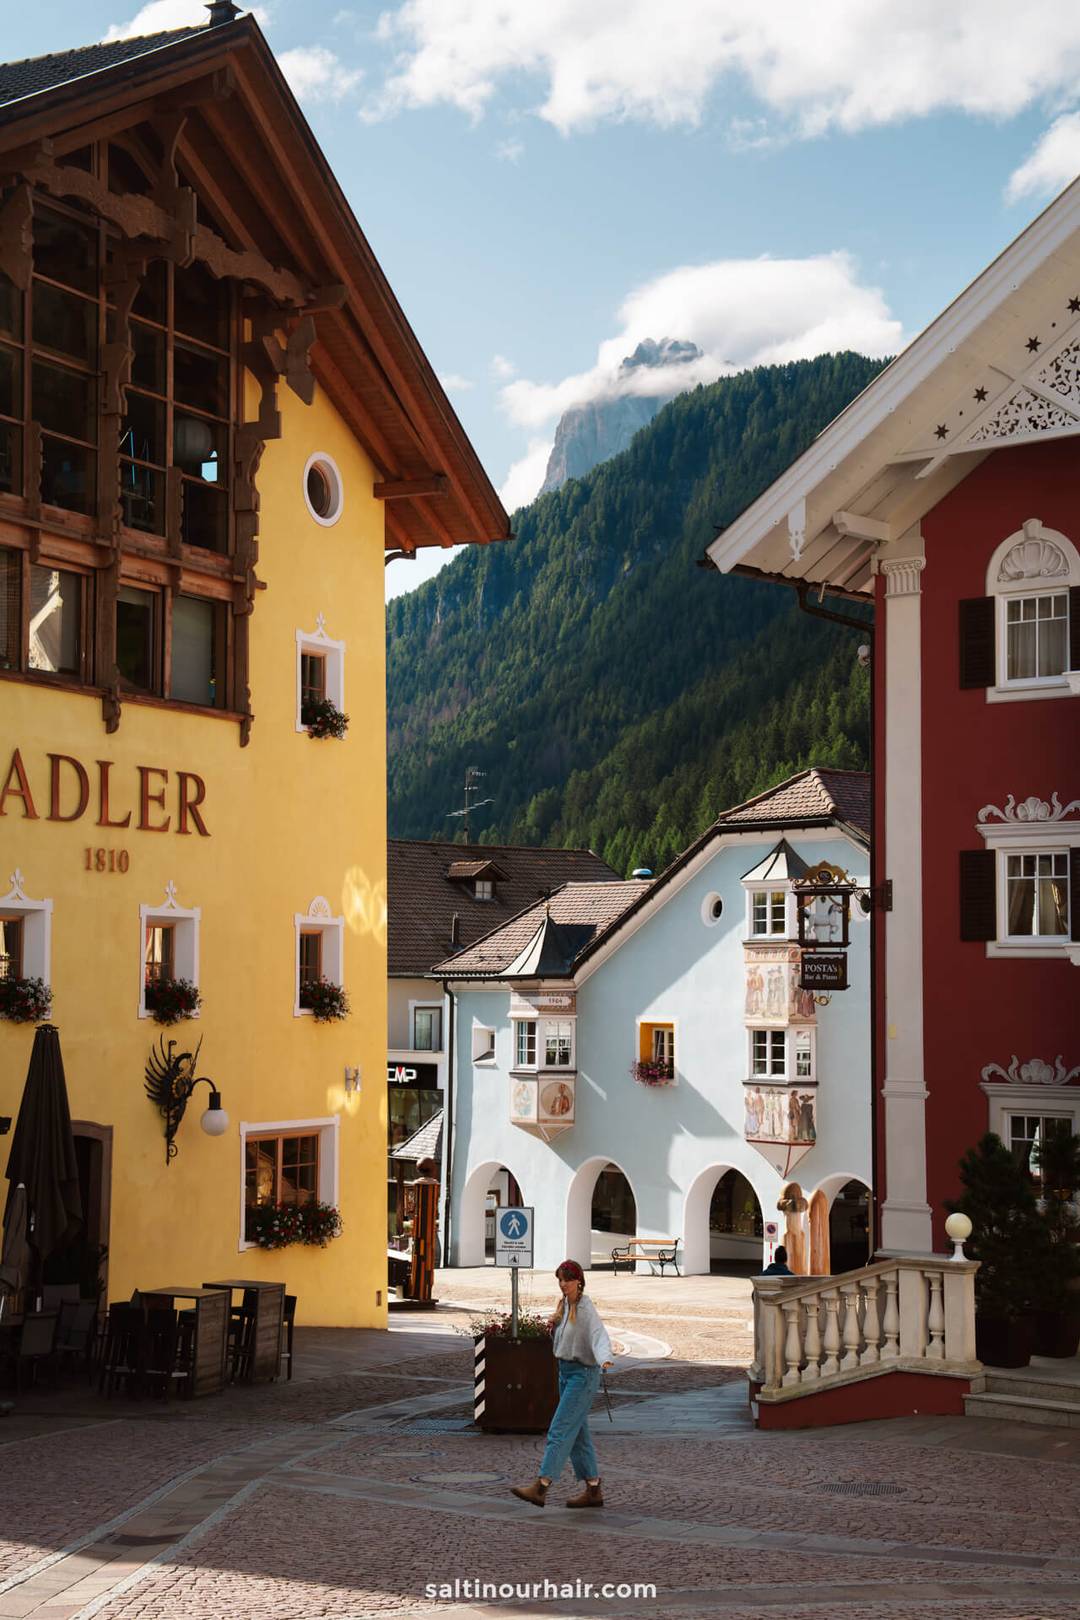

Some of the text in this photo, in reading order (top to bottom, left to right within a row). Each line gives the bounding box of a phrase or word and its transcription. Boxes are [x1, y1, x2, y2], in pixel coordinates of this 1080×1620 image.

[0, 747, 212, 837] ADLER
[84, 848, 130, 873] 1810
[386, 1066, 417, 1083] CMP
